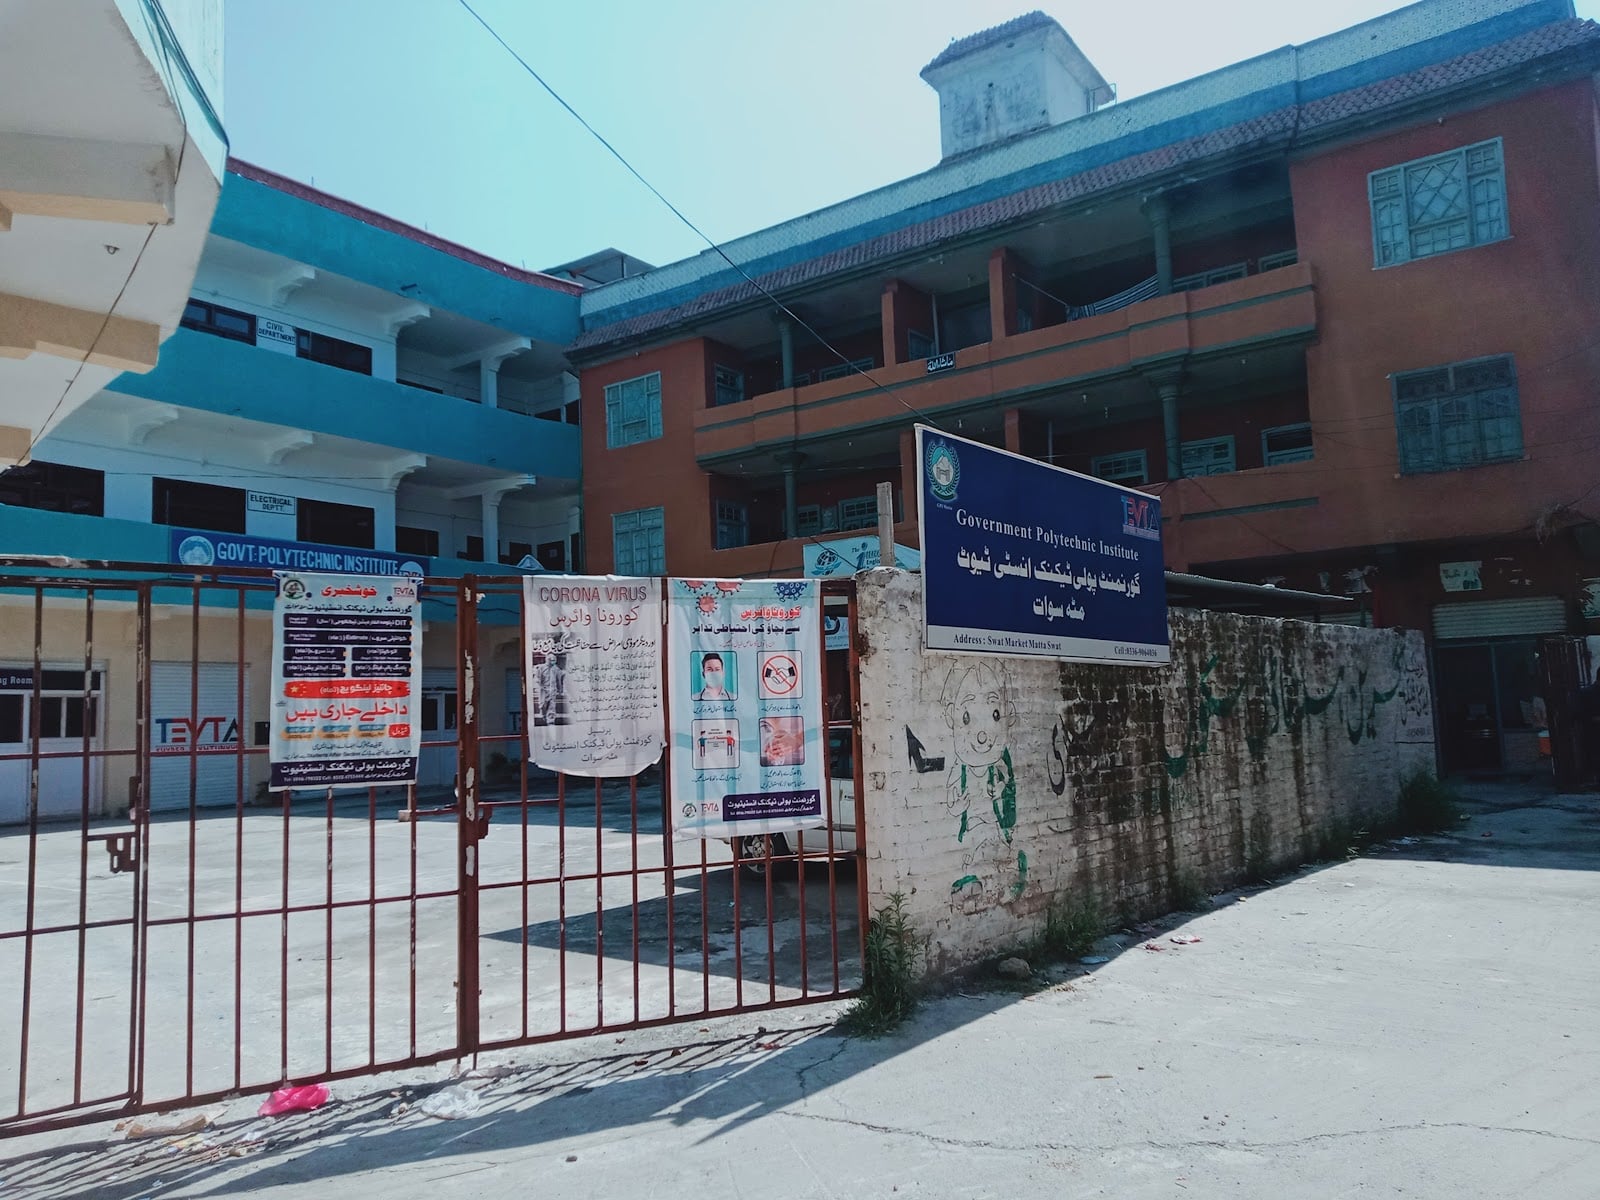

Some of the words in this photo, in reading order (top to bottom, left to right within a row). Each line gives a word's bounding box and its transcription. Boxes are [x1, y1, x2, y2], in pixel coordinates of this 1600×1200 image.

[258, 327, 296, 342] DEPARTMENT
[266, 321, 284, 332] CIVIL
[250, 494, 292, 506] ELECTRICAL
[956, 508, 1032, 540] Government
[1036, 526, 1096, 553] Polytechnic
[1099, 540, 1139, 561] Institute
[258, 546, 343, 569] POLYTECHNIC
[344, 555, 399, 575] INSTITUTE
[957, 545, 992, 575] ٹیوٹ
[994, 551, 1032, 579] انسٹی
[1034, 560, 1072, 588] ٹیکنک
[1072, 567, 1098, 595] پولی
[321, 584, 378, 598] خوشخبری
[1099, 570, 1141, 599] گورنمنٹ
[540, 586, 601, 602] CORONA
[605, 586, 647, 601] VIRUS
[597, 605, 640, 626] کورونا
[740, 606, 771, 620] وائرس
[771, 606, 801, 620] کورونا
[1033, 595, 1064, 622] سوات
[1066, 597, 1085, 621] مٹہ
[549, 607, 592, 627] وائرس
[714, 623, 750, 634] احتیاطی
[752, 623, 765, 635] کی
[785, 626, 800, 635] سے
[987, 635, 1004, 646] Swat
[1005, 637, 1028, 648] Market
[1028, 639, 1047, 649] Matta
[1047, 640, 1062, 651] Swat
[10, 676, 33, 685] Room
[285, 709, 318, 722] ہیں
[319, 703, 361, 721] جاری
[360, 702, 408, 721] داخلے
[581, 753, 603, 763] سوات
